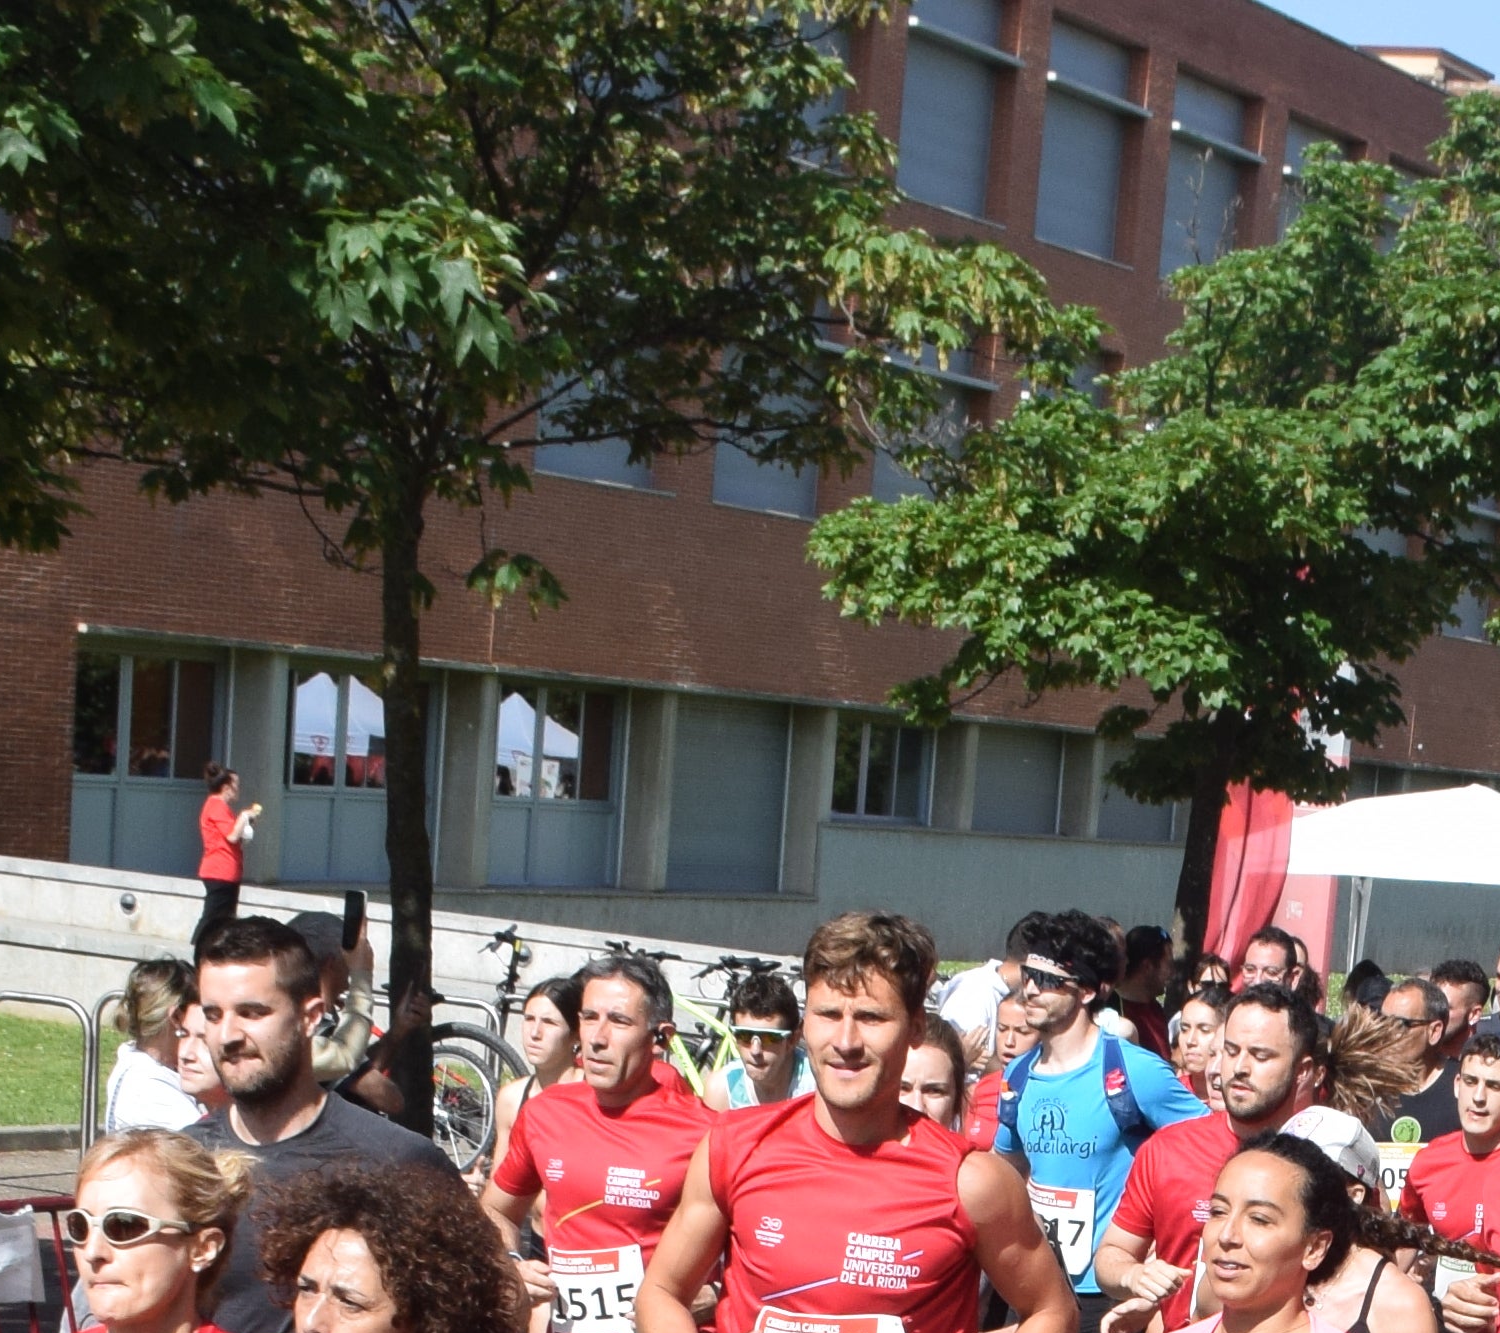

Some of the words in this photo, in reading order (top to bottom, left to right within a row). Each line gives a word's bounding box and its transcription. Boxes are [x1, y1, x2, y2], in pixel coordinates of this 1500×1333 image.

[606, 1176, 641, 1188] CAMPUS
[605, 1185, 660, 1201] UNIVERSIDAD
[847, 1232, 902, 1250] CARRERA
[845, 1246, 896, 1263] CAMPUS
[843, 1258, 921, 1279] UNIVERSIDAD
[840, 1271, 857, 1284] DE
[858, 1272, 874, 1286] LA
[876, 1274, 908, 1290] RIOJA
